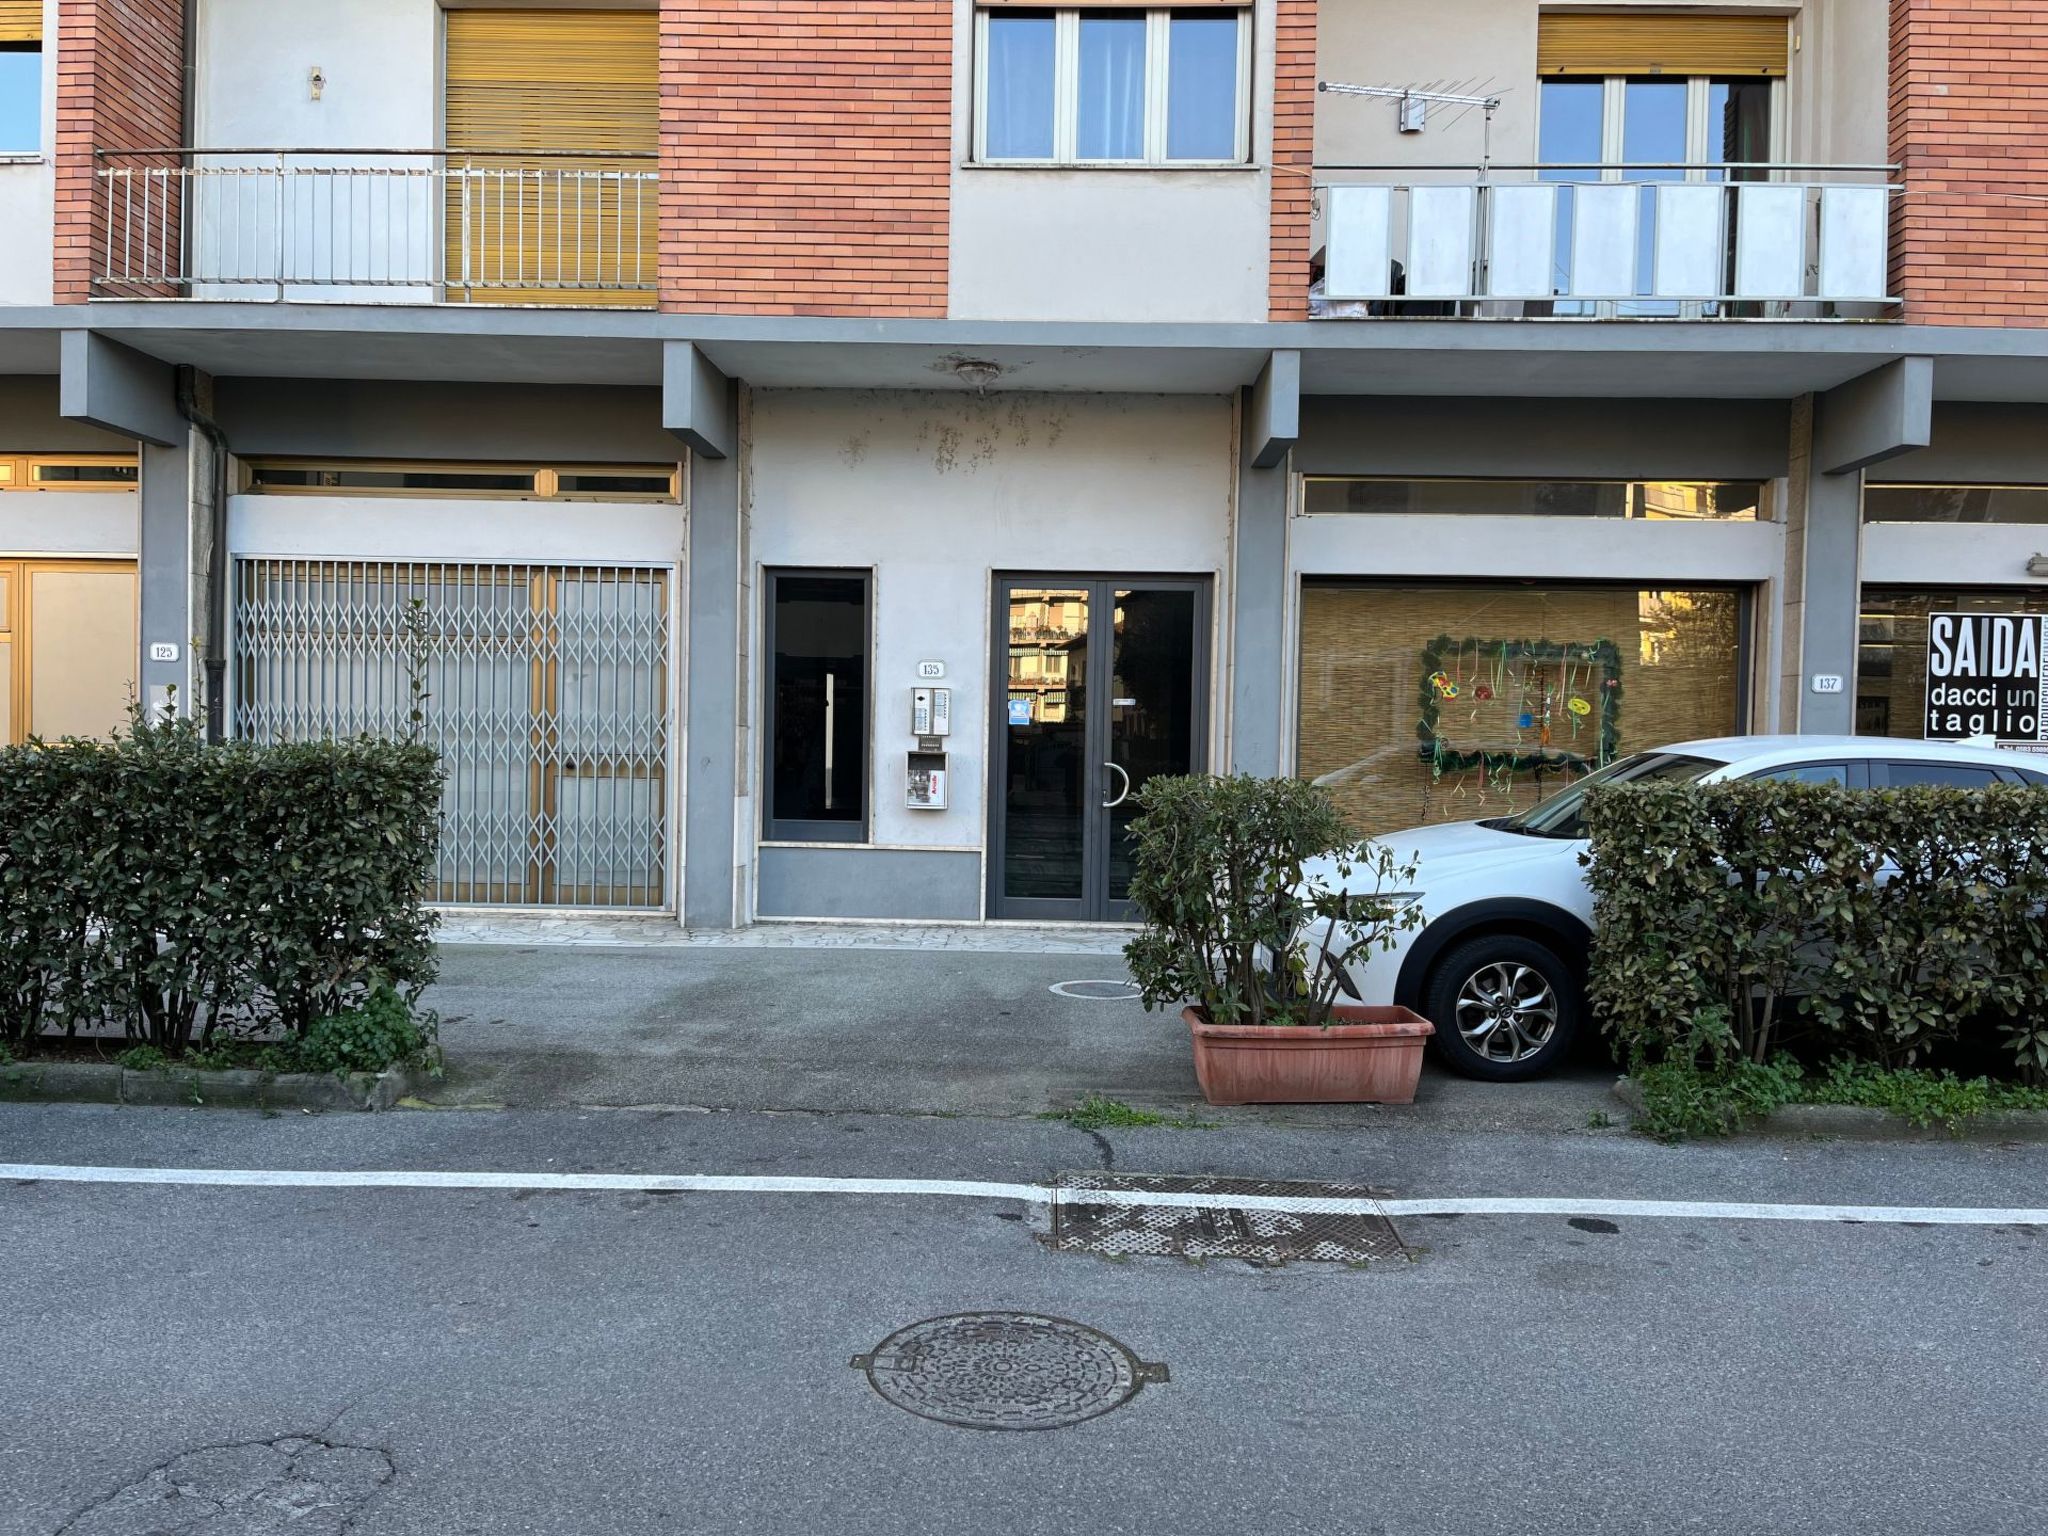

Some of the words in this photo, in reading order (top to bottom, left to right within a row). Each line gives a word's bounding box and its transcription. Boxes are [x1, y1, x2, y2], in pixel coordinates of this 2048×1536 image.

[156, 647, 172, 658] 125
[1931, 616, 2037, 678] SAIDA
[924, 664, 939, 675] 135
[1820, 678, 1837, 689] 137
[1931, 682, 1997, 707] dacci
[2007, 689, 2036, 707] un
[1930, 709, 2036, 737] taglio
